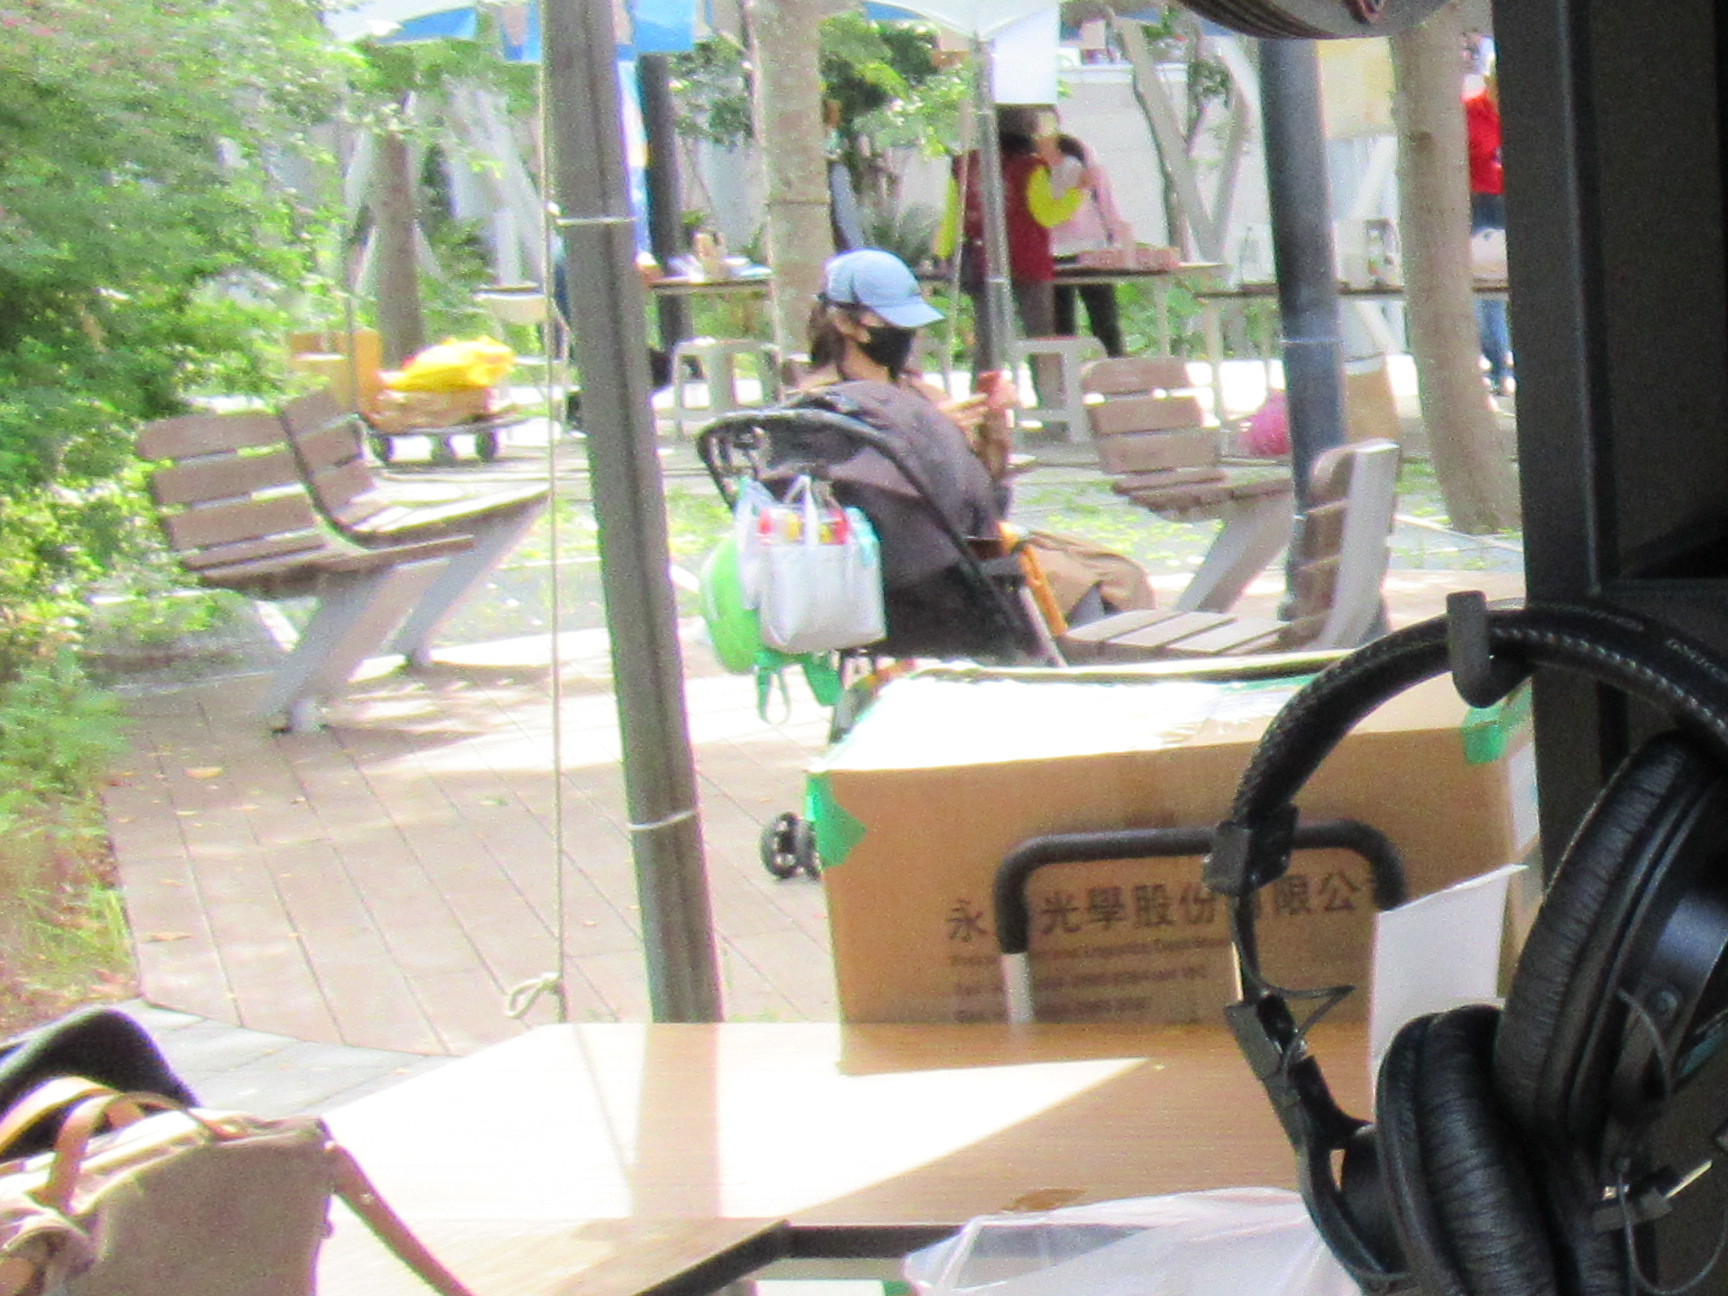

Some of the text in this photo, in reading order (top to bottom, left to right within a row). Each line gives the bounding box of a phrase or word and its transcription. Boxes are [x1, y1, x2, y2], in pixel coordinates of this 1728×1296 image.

[946, 870, 1378, 944] 永光學股份限公
